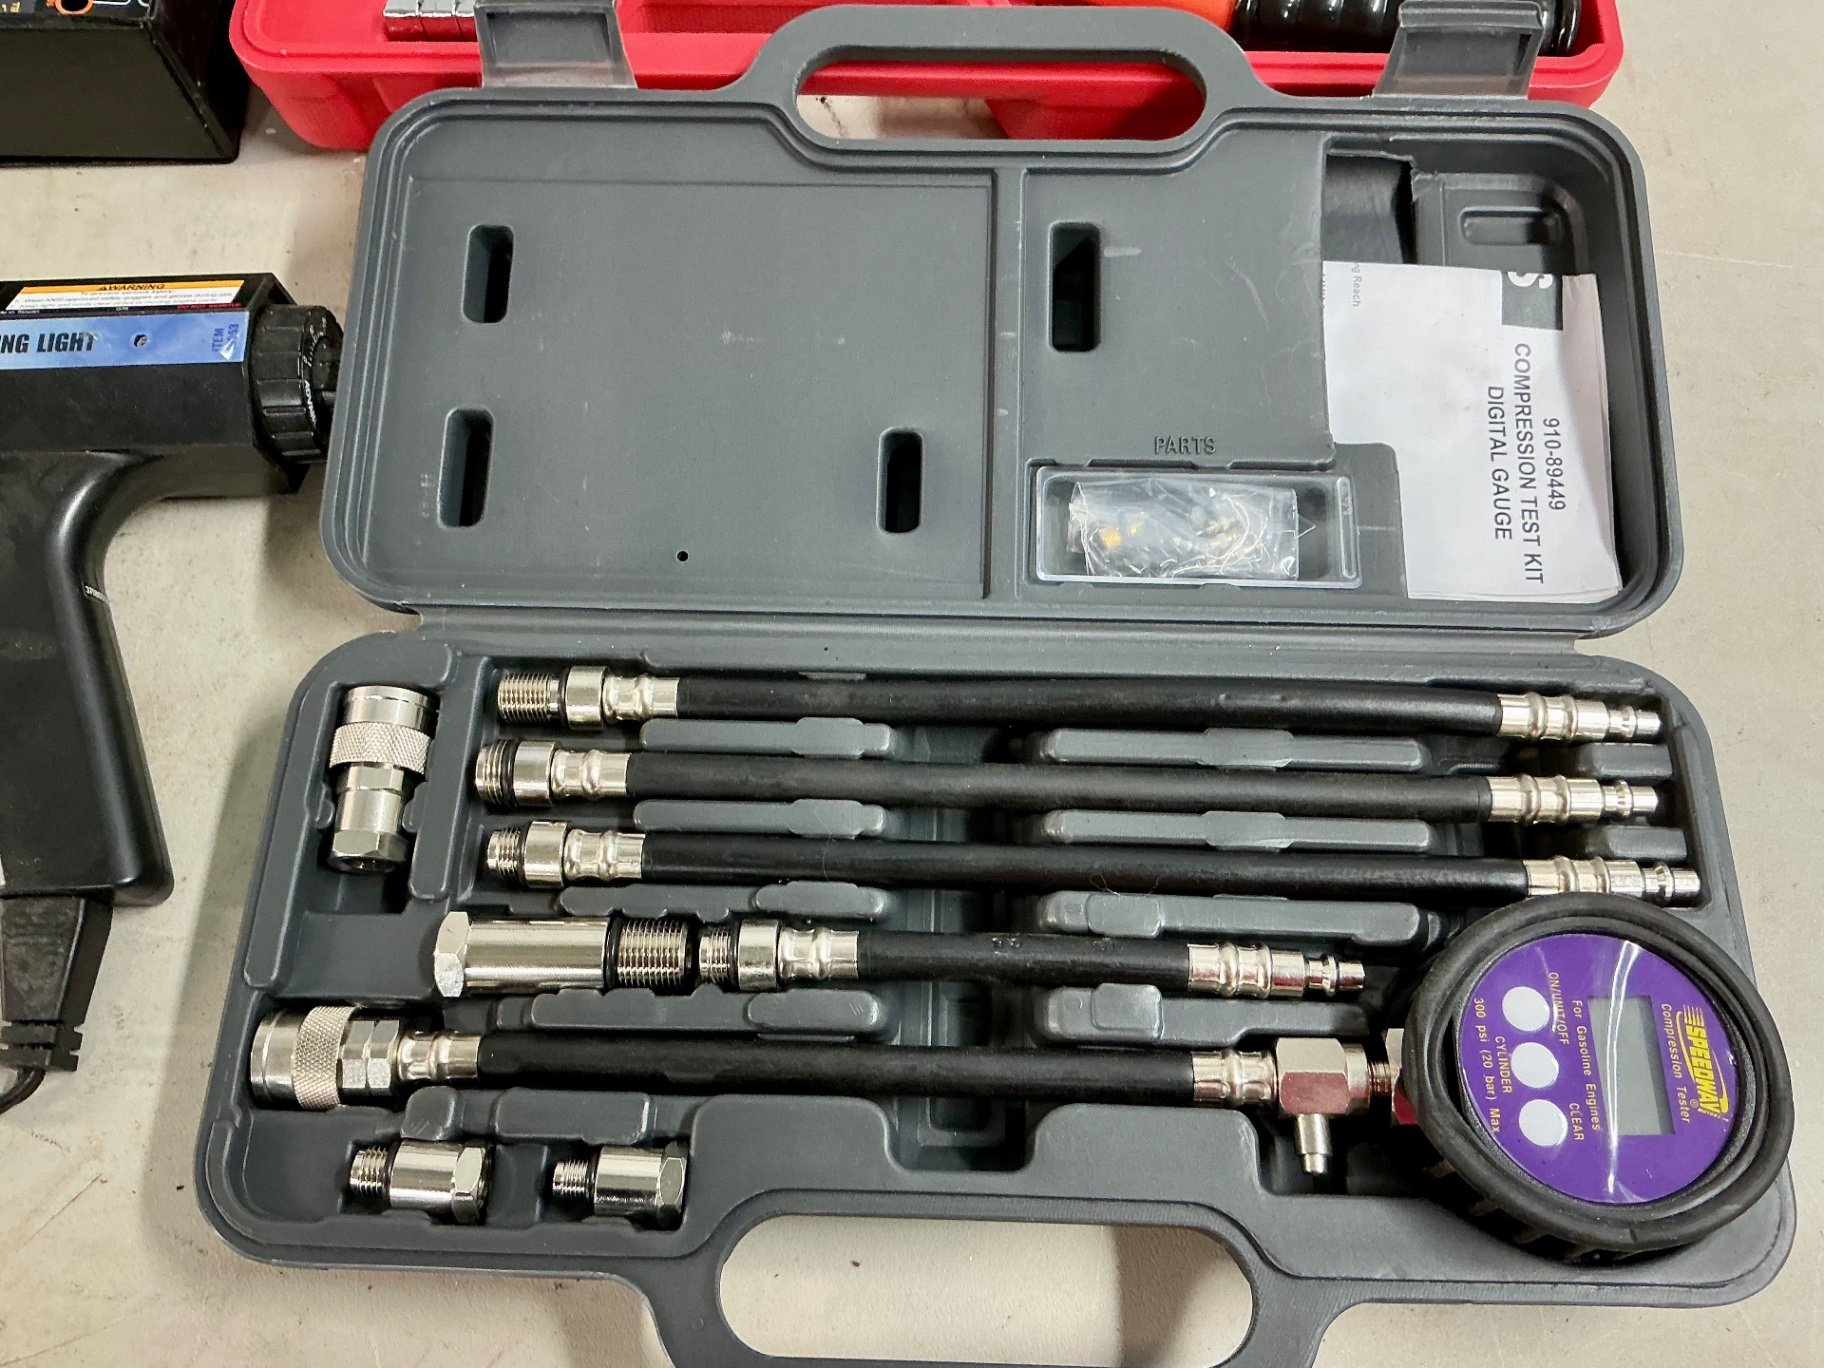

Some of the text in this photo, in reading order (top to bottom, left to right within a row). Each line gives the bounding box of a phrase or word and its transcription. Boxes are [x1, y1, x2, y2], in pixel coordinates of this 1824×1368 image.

[106, 283, 165, 291] WARNING
[1352, 276, 1362, 307] Reach
[0, 331, 95, 354] NG LIGHT
[211, 328, 224, 352] ITEM
[1154, 435, 1216, 455] PARTS
[1487, 386, 1512, 540] DIGITAL GAUGE
[1514, 343, 1544, 583] COMPRESSION TEST KIT
[1543, 418, 1566, 511] 910-89449
[1549, 972, 1569, 1045] ON/UNIT/OFF
[1473, 997, 1500, 1133] 300 psi (20 bar) Max
[1494, 1035, 1513, 1094] CYLINDER
[1572, 1000, 1600, 1131] For Gasoline Engines
[1661, 1003, 1691, 1124] Compression Tester
[1685, 1022, 1721, 1114] SPEEDWAY
[1568, 1102, 1585, 1141] CLEAR
